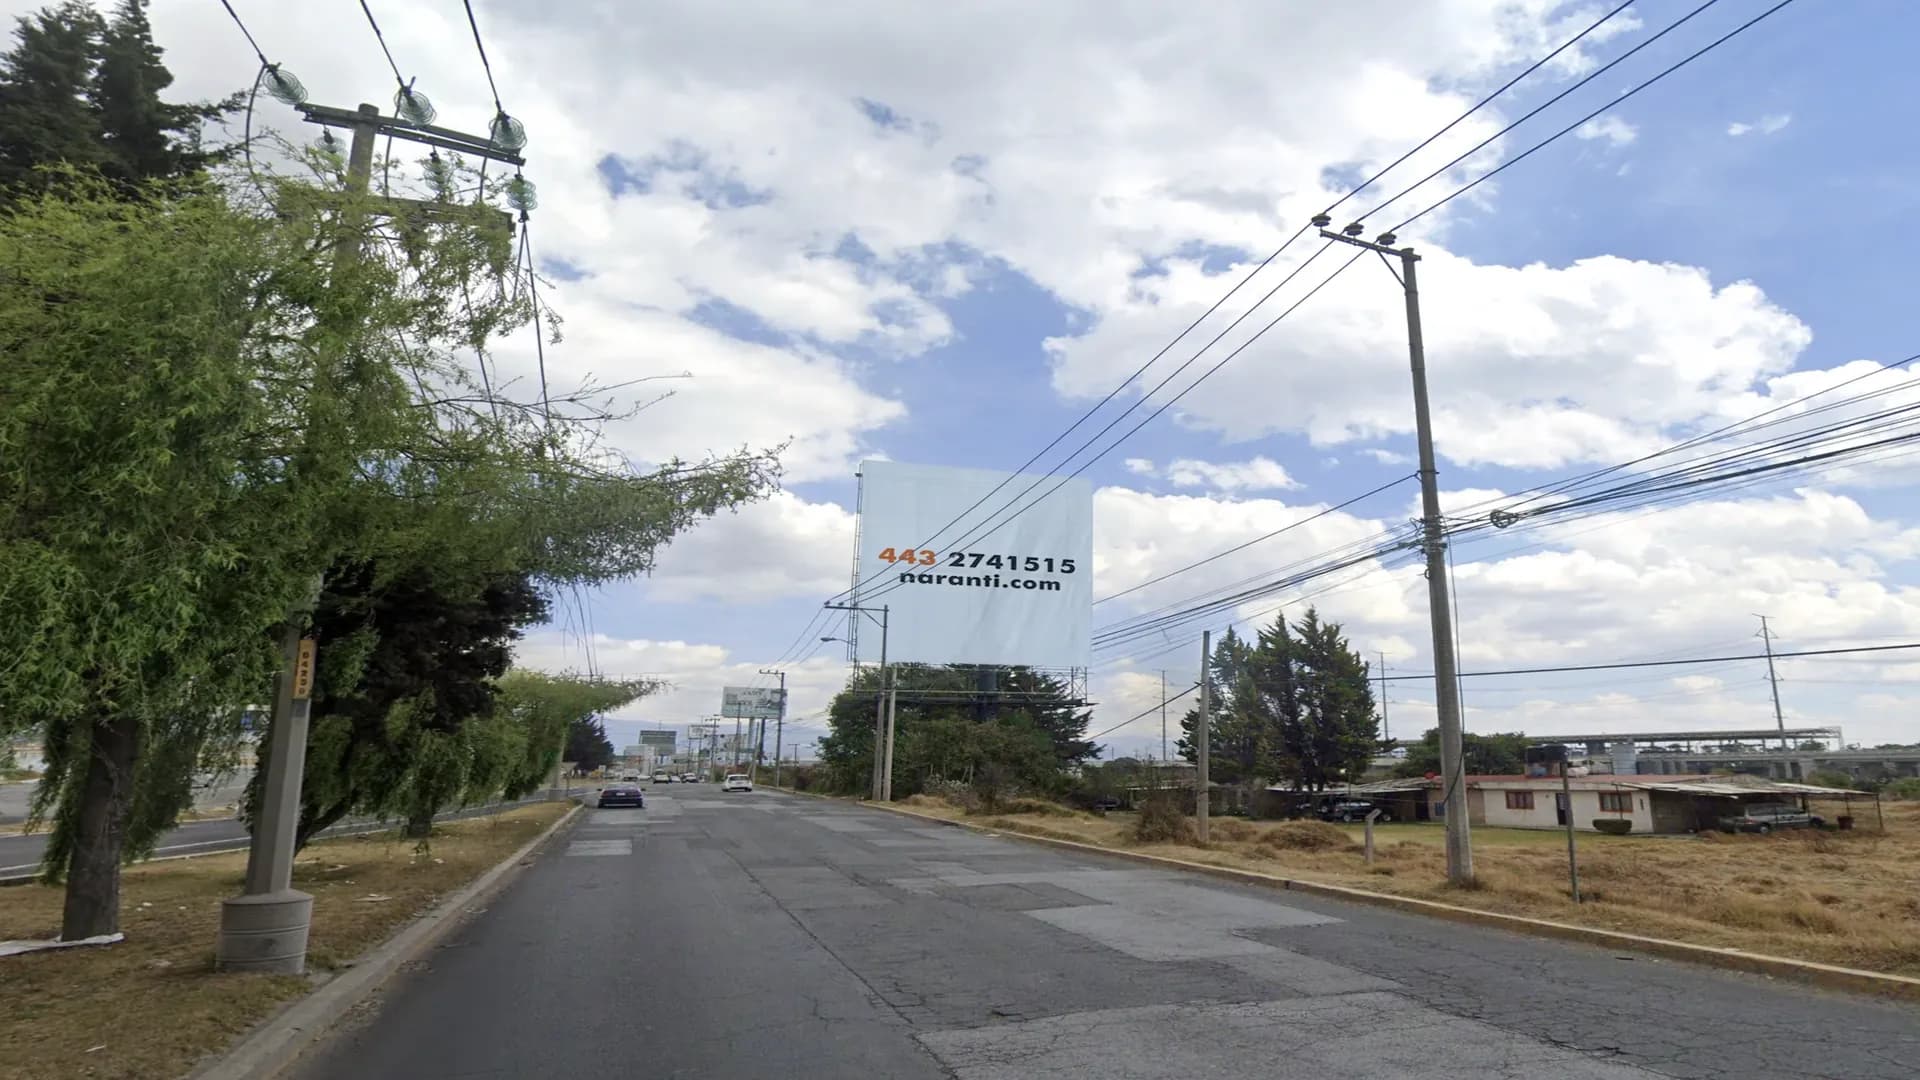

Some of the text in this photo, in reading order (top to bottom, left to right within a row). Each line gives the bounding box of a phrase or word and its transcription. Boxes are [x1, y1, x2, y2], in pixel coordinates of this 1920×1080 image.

[878, 547, 1076, 574] 443 2741515
[899, 572, 1062, 591] naranti.com
